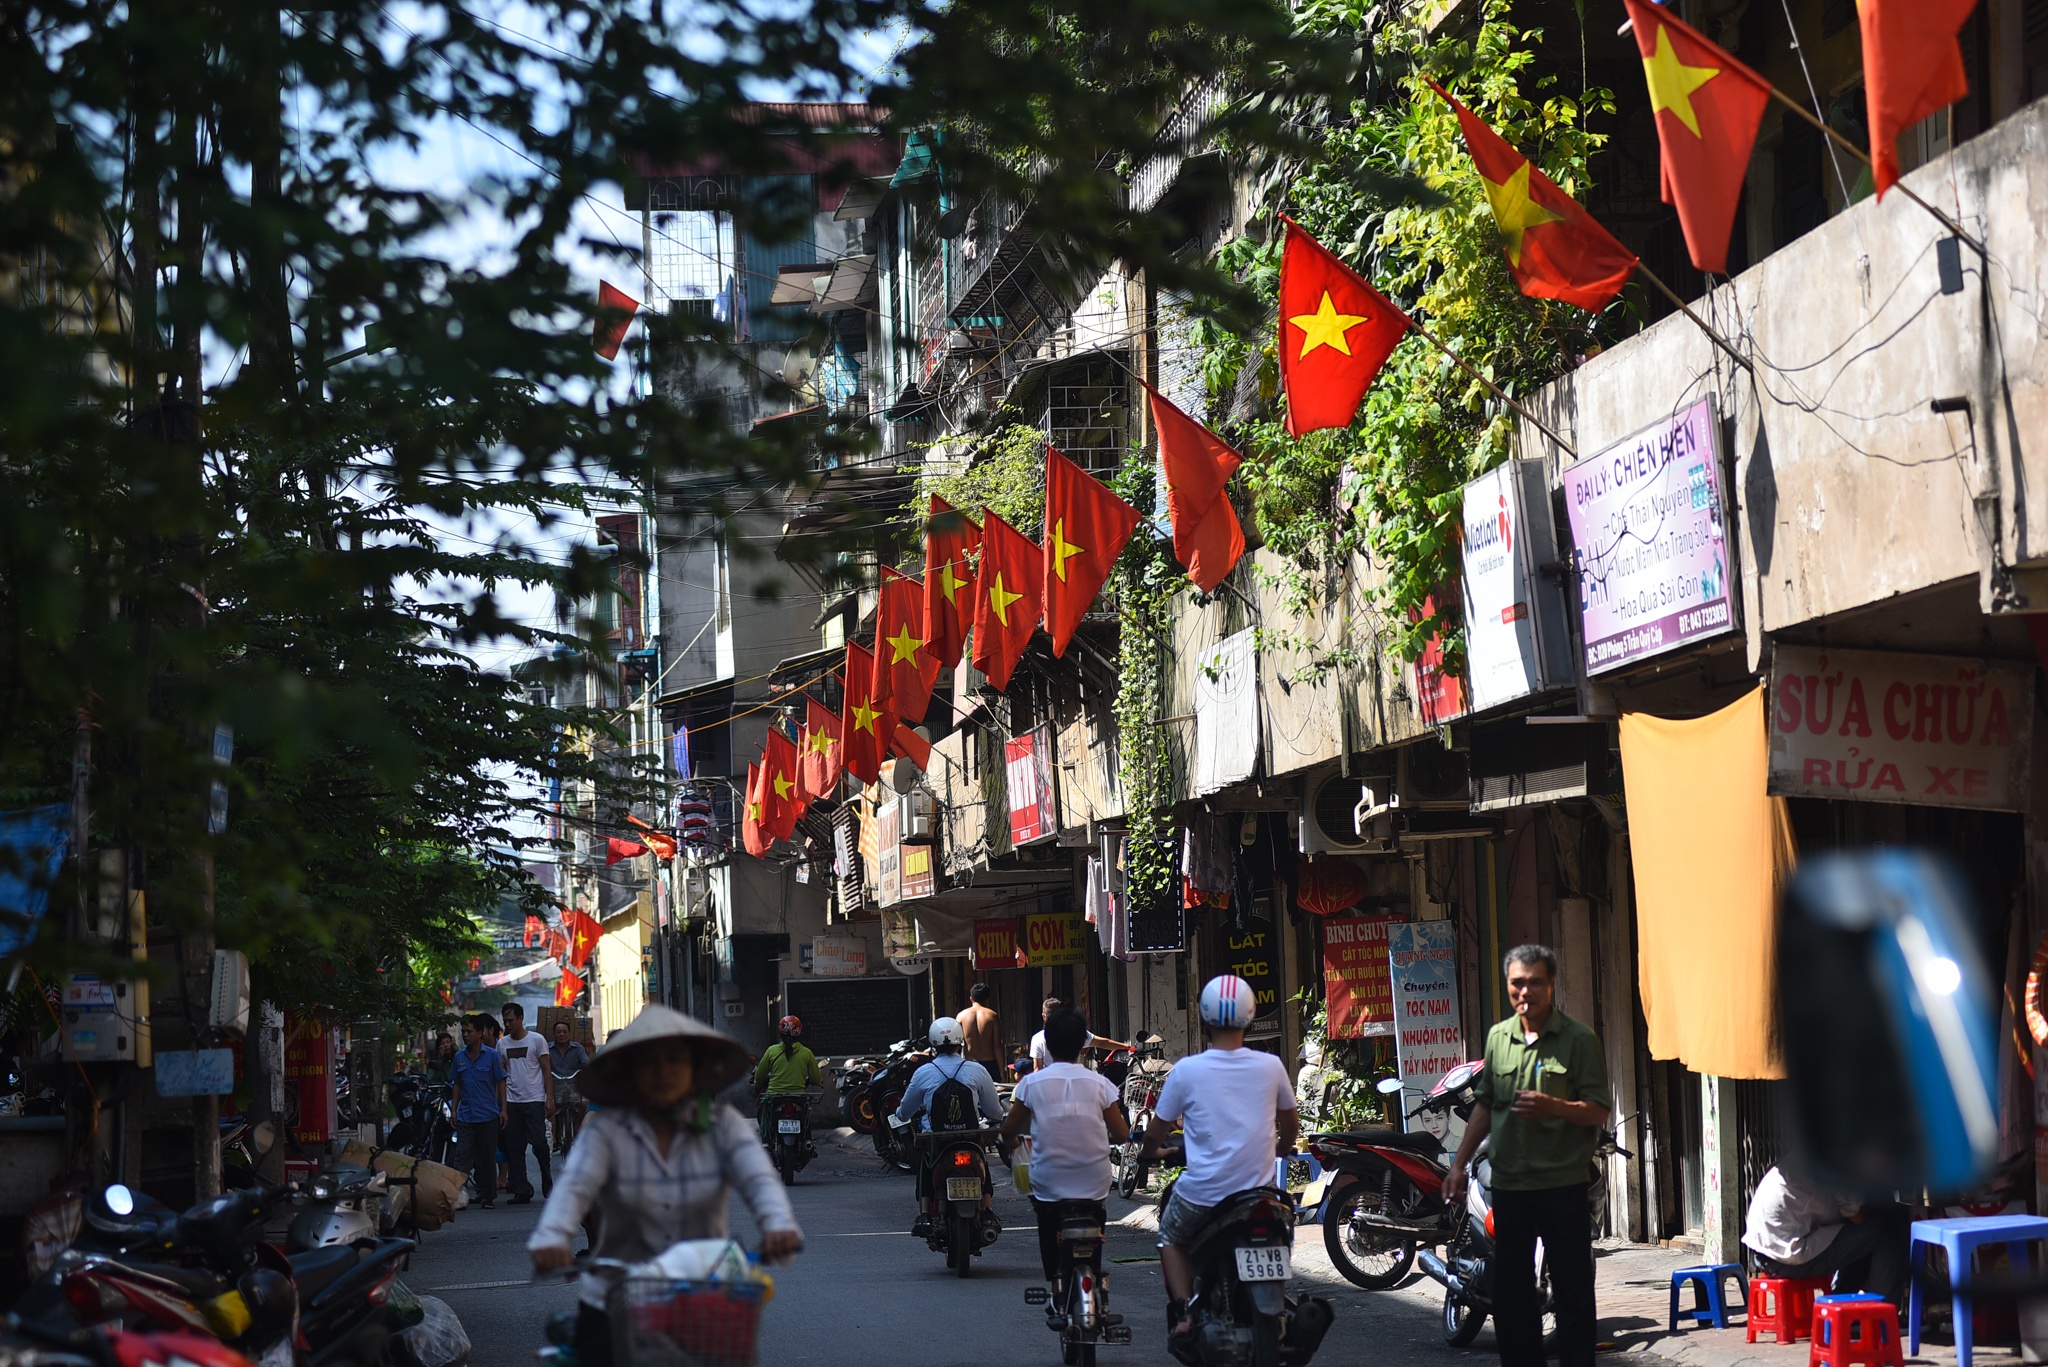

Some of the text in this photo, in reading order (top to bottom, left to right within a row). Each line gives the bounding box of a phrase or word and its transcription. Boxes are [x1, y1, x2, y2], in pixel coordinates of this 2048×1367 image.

[1614, 439, 1656, 487] CHIẾN
[1629, 497, 1650, 526] Thái
[1654, 536, 1669, 566] Nha
[1669, 530, 1694, 558] Trang
[1694, 520, 1710, 549] 584
[1619, 594, 1637, 620] Hoa
[1660, 580, 1676, 606] Sài
[1678, 574, 1699, 599] Gòn
[1776, 654, 2013, 748] SỬA CHỮA
[1802, 747, 1989, 798] RỬA XE
[1029, 916, 1065, 951] CƠM
[1325, 920, 1355, 944] BÌNH
[816, 940, 865, 968] Cháo Lòng
[978, 931, 1011, 959] CHIM
[1342, 944, 1357, 961] CẮT
[1358, 945, 1372, 960] TÓC
[1232, 957, 1269, 978] TÓC
[1327, 965, 1340, 981] TẨY
[1342, 964, 1356, 980] NỐT
[1378, 984, 1390, 997] TAI
[1404, 981, 1449, 994] Chuyên:
[728, 1004, 741, 1014] 66
[1381, 1002, 1393, 1015] TAI
[1406, 996, 1451, 1017] TÓC NAM
[1402, 1025, 1439, 1050] NHUỘM
[1440, 1023, 1459, 1044] TÓC
[1404, 1050, 1421, 1076] TẨY
[1421, 1050, 1439, 1075] NỐT
[300, 1128, 321, 1142] PHÍ
[943, 1122, 967, 1131] MUTANT
[1244, 1249, 1282, 1264] 21-V8
[1247, 1263, 1285, 1278] 5968
